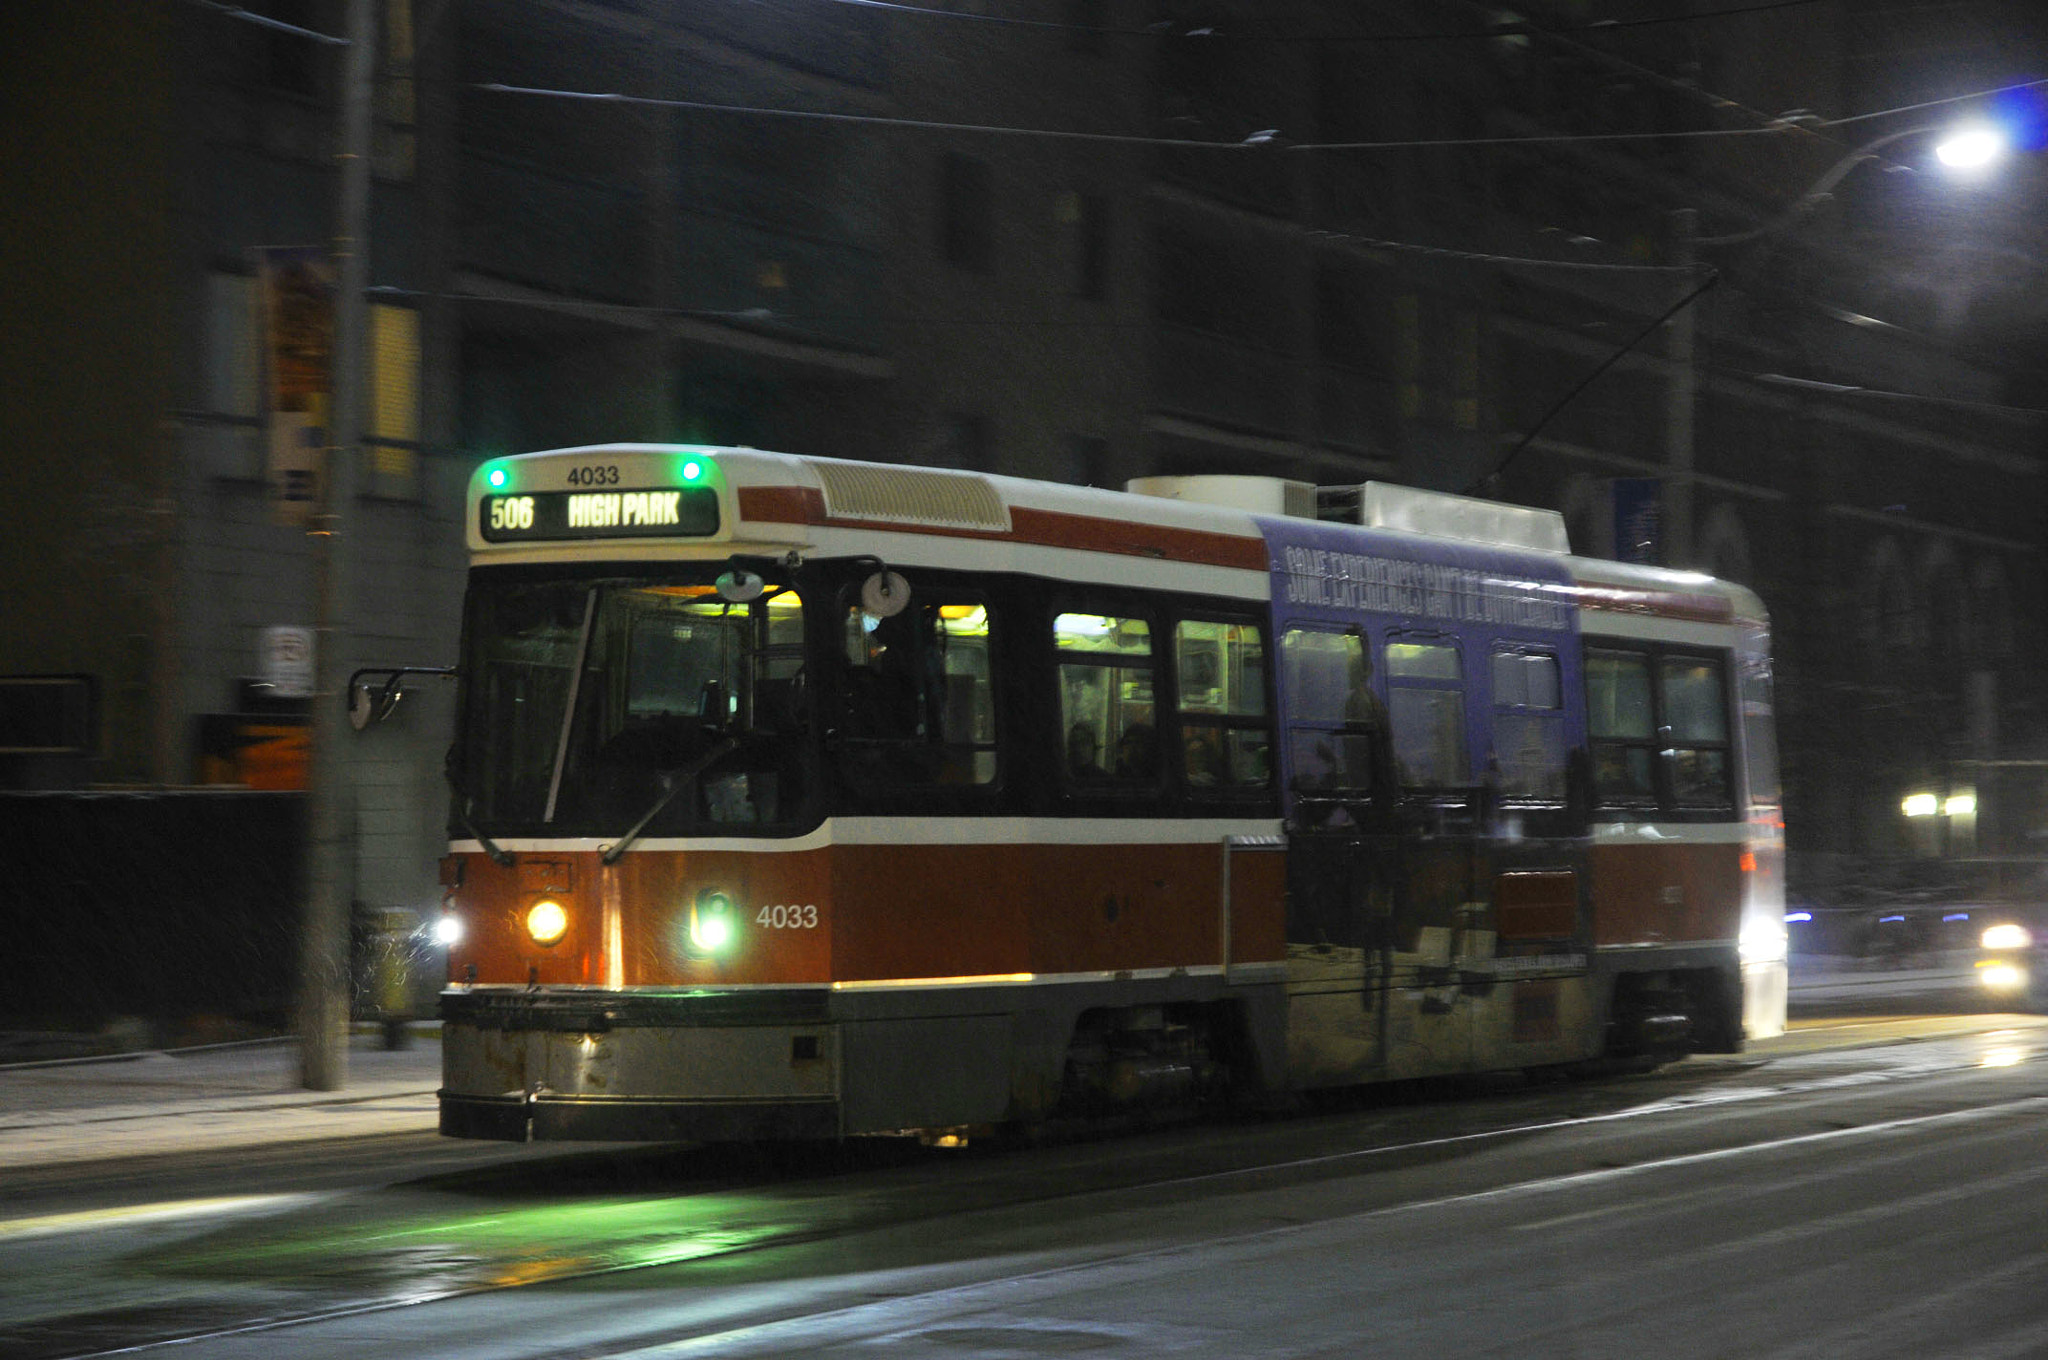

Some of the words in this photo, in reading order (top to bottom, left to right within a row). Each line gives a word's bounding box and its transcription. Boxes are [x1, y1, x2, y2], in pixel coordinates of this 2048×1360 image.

[567, 465, 620, 486] 4033
[490, 496, 535, 530] 506
[568, 494, 620, 528] HIGH
[622, 491, 681, 527] PARK
[756, 904, 819, 929] 4033
